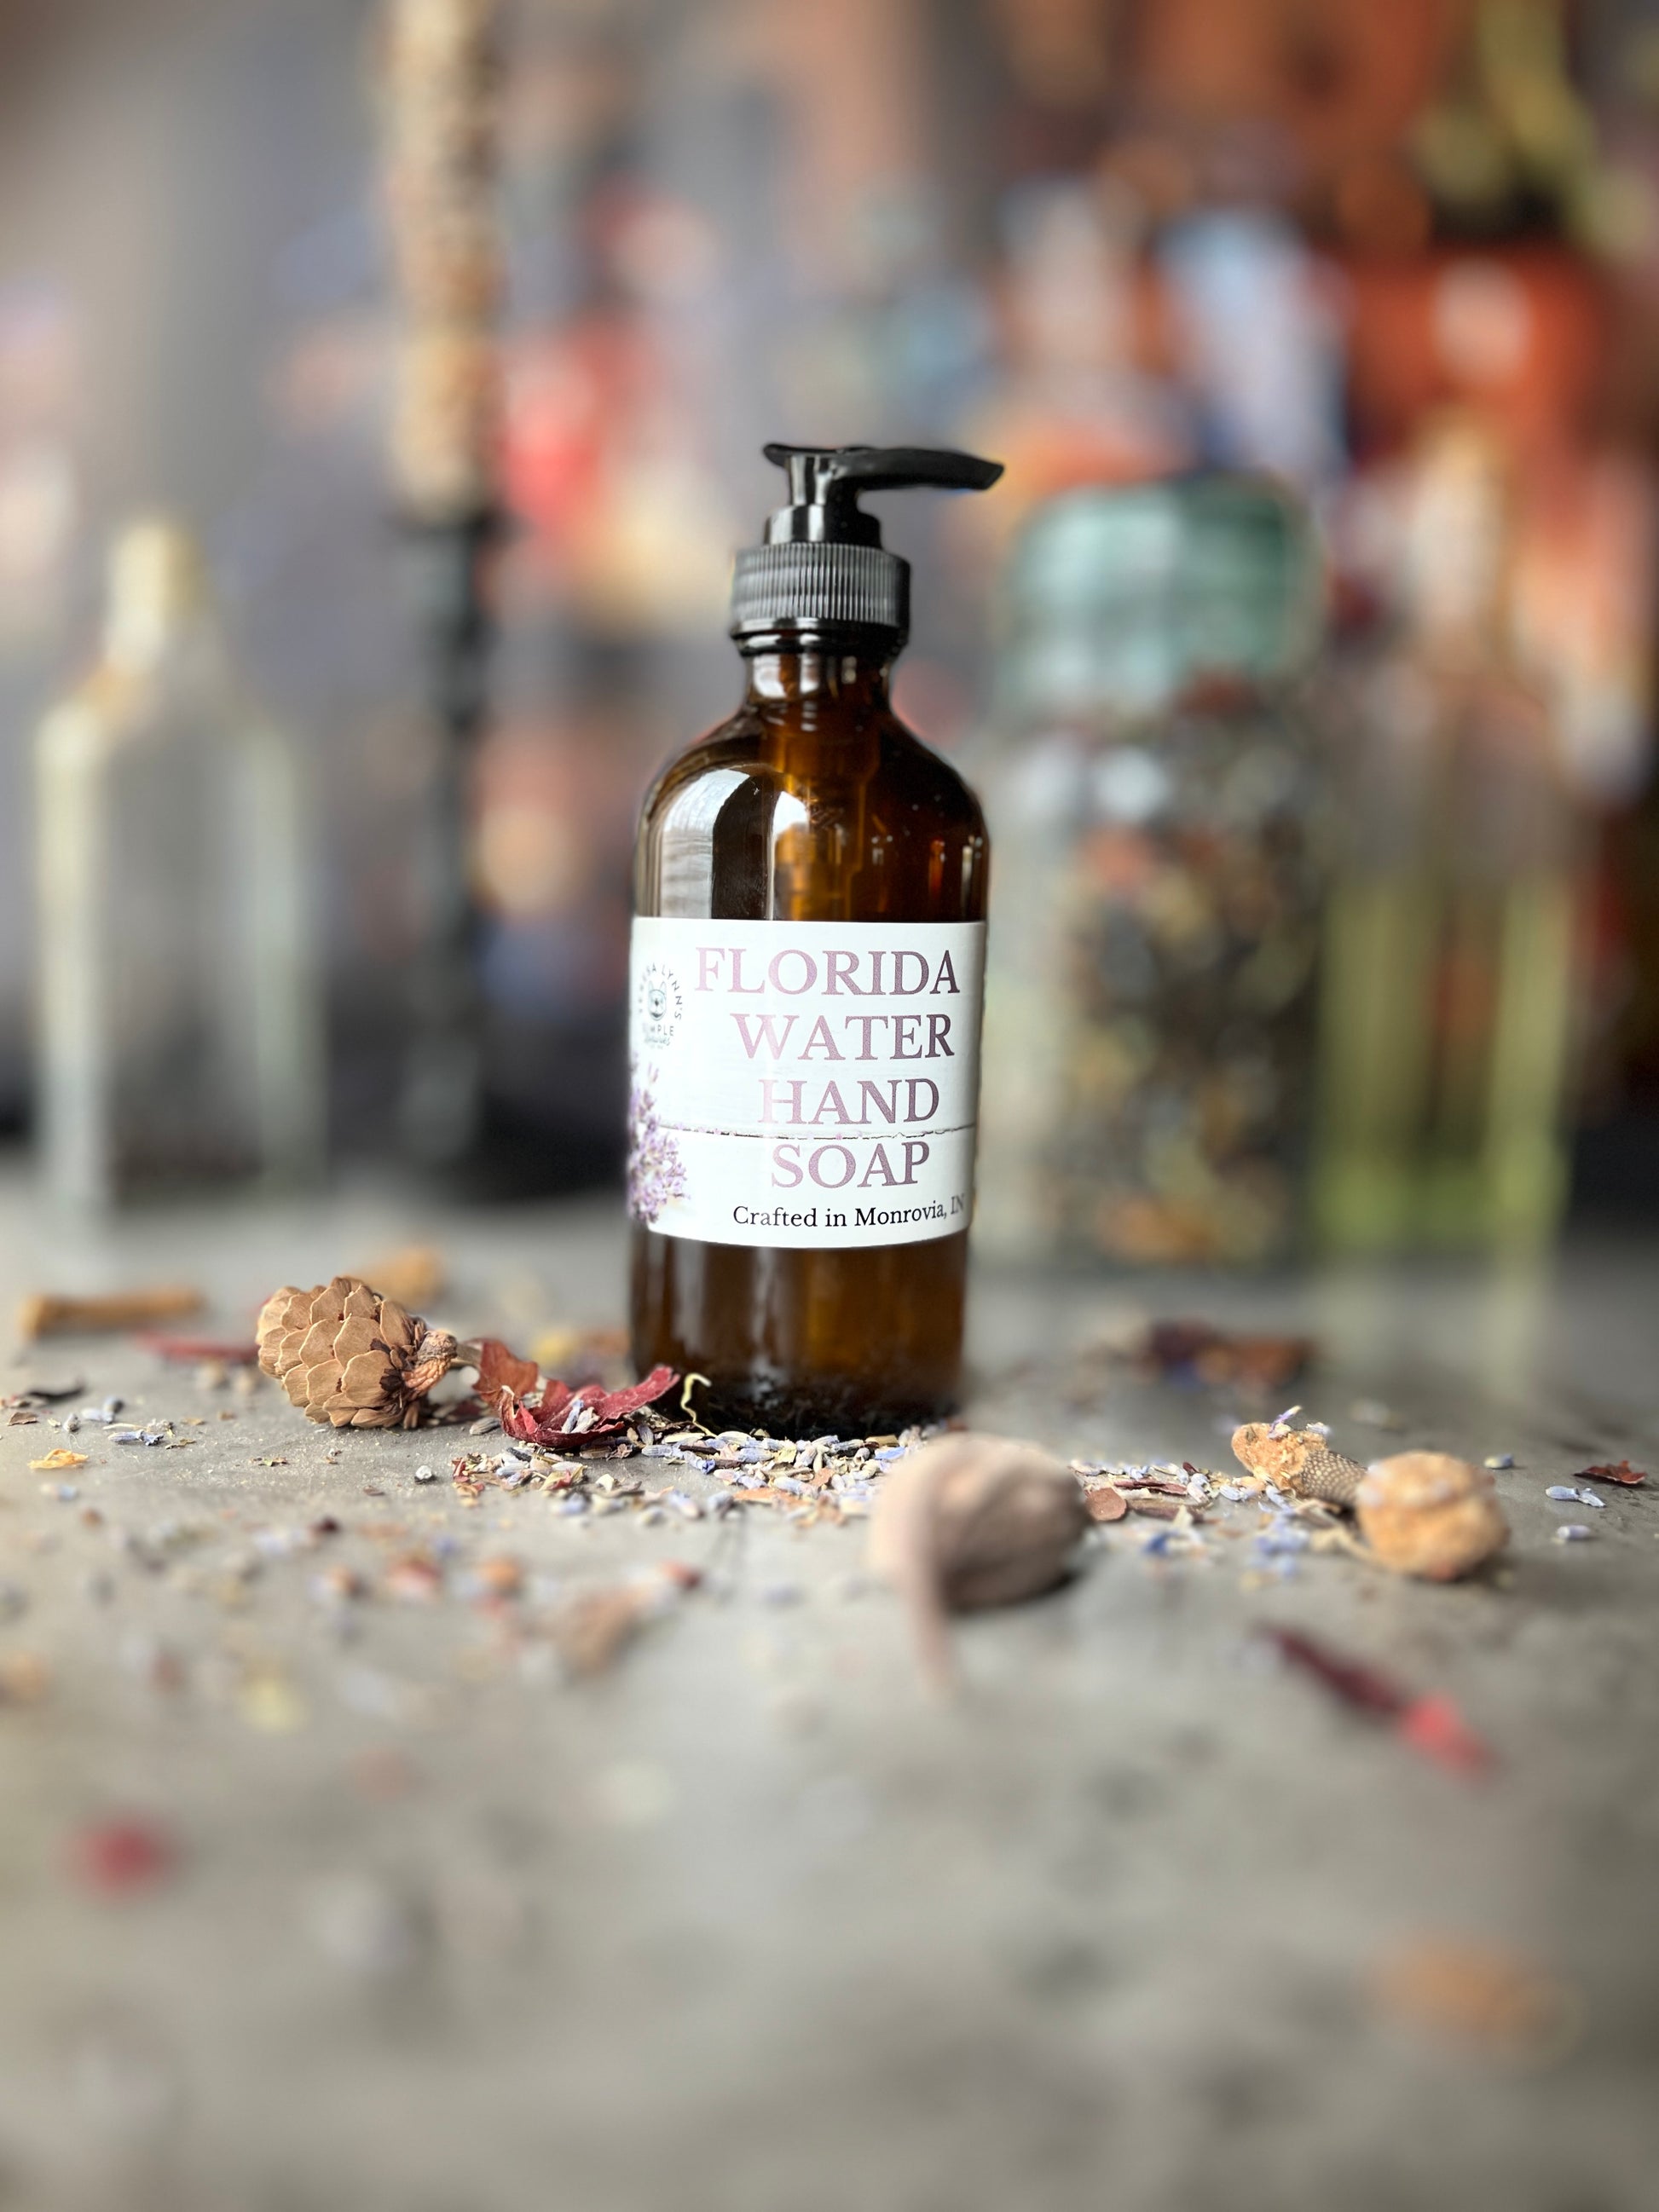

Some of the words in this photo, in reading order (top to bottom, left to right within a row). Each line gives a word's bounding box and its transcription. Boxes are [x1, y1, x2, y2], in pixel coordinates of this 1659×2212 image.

[694, 946, 960, 996] FLORIDA
[730, 1013, 955, 1061] WATER
[758, 1077, 939, 1125] HAND
[771, 1141, 930, 1189] SOAP
[733, 1205, 818, 1227] Crafted
[824, 1208, 847, 1227] in
[854, 1199, 947, 1227] Monrovia,
